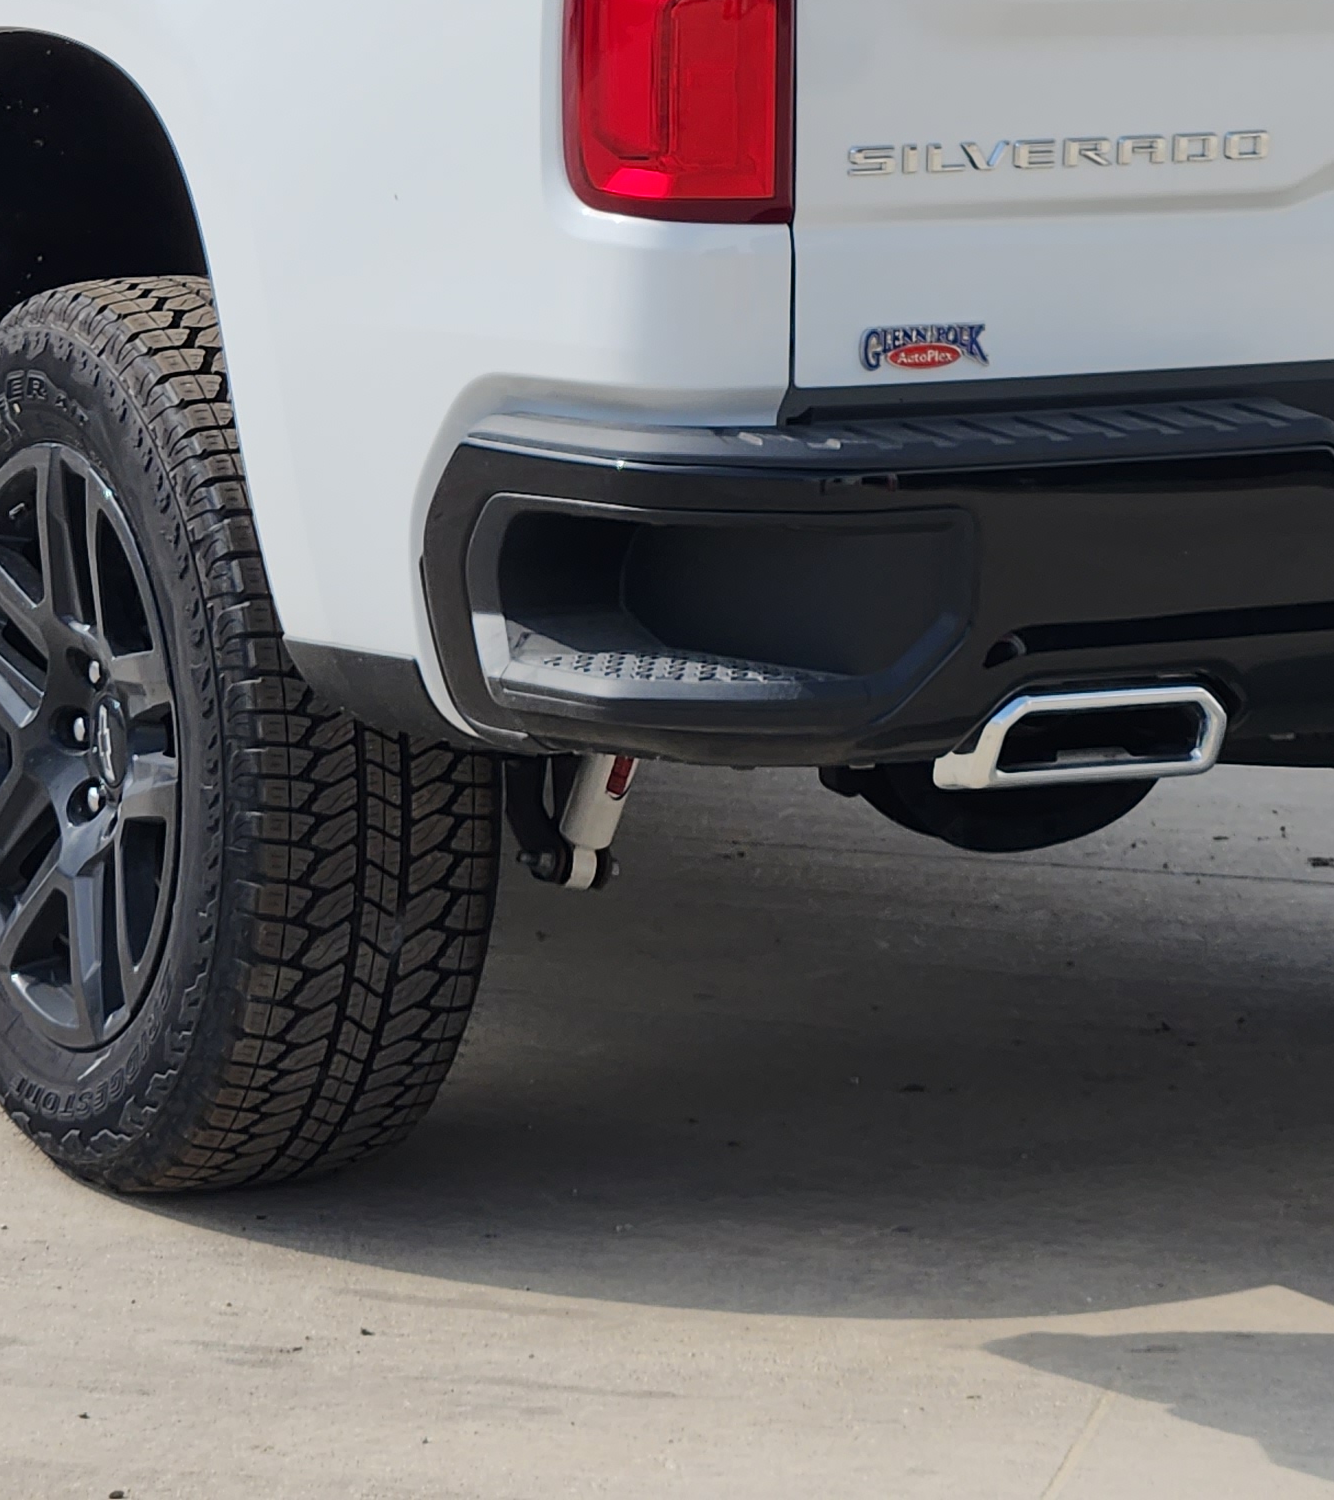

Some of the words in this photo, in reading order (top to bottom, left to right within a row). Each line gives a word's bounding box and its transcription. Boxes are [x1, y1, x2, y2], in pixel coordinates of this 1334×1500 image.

[847, 129, 1270, 176] SILVERADO
[859, 325, 929, 371] GLENN
[932, 322, 990, 366] POLK
